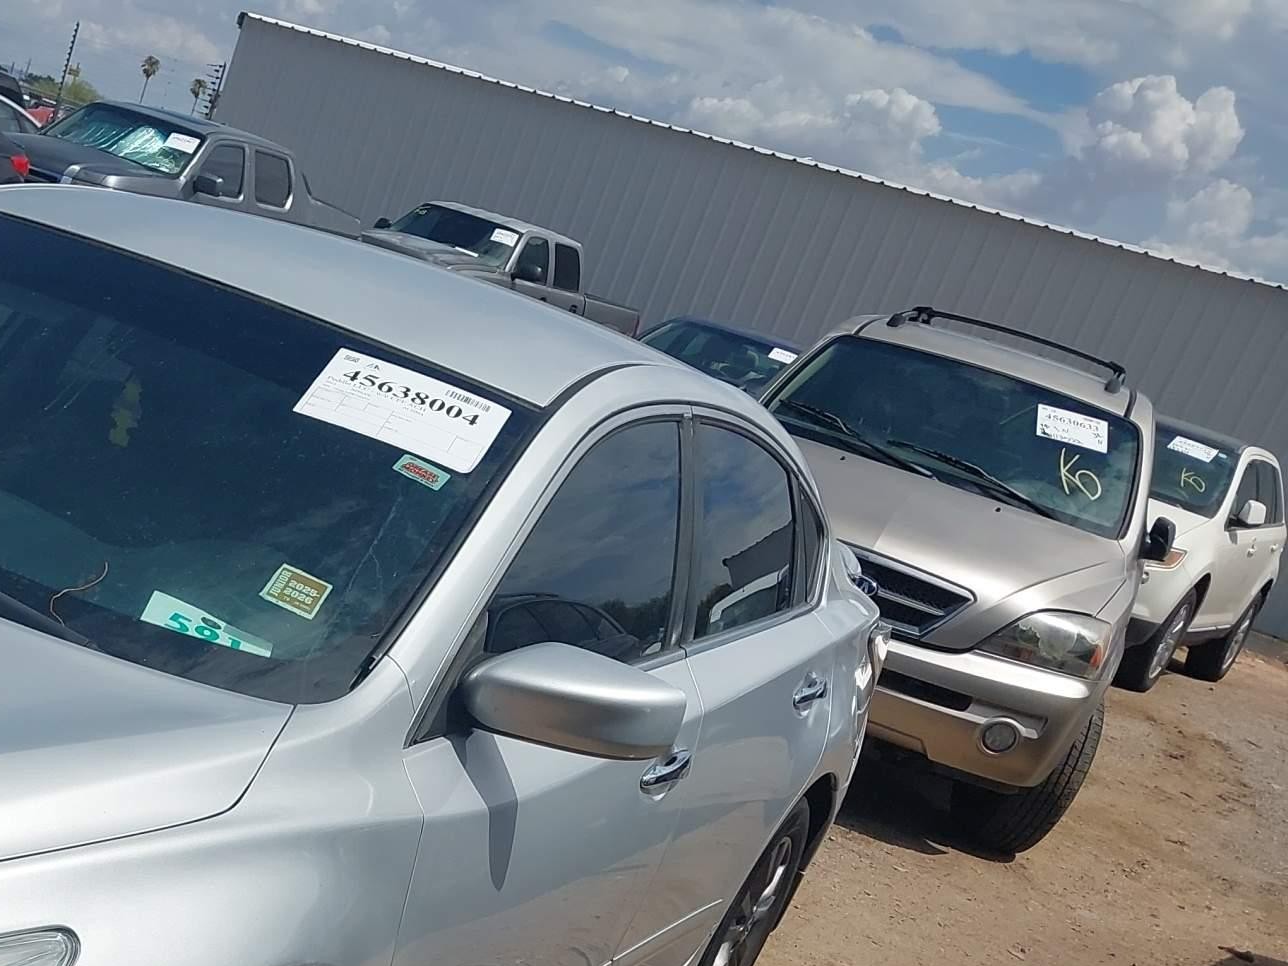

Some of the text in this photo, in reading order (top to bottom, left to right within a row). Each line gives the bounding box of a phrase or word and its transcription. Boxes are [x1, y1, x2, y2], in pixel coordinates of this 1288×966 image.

[343, 371, 479, 426] 45638004
[269, 570, 292, 597] JUNIOR
[283, 587, 313, 605] 2026
